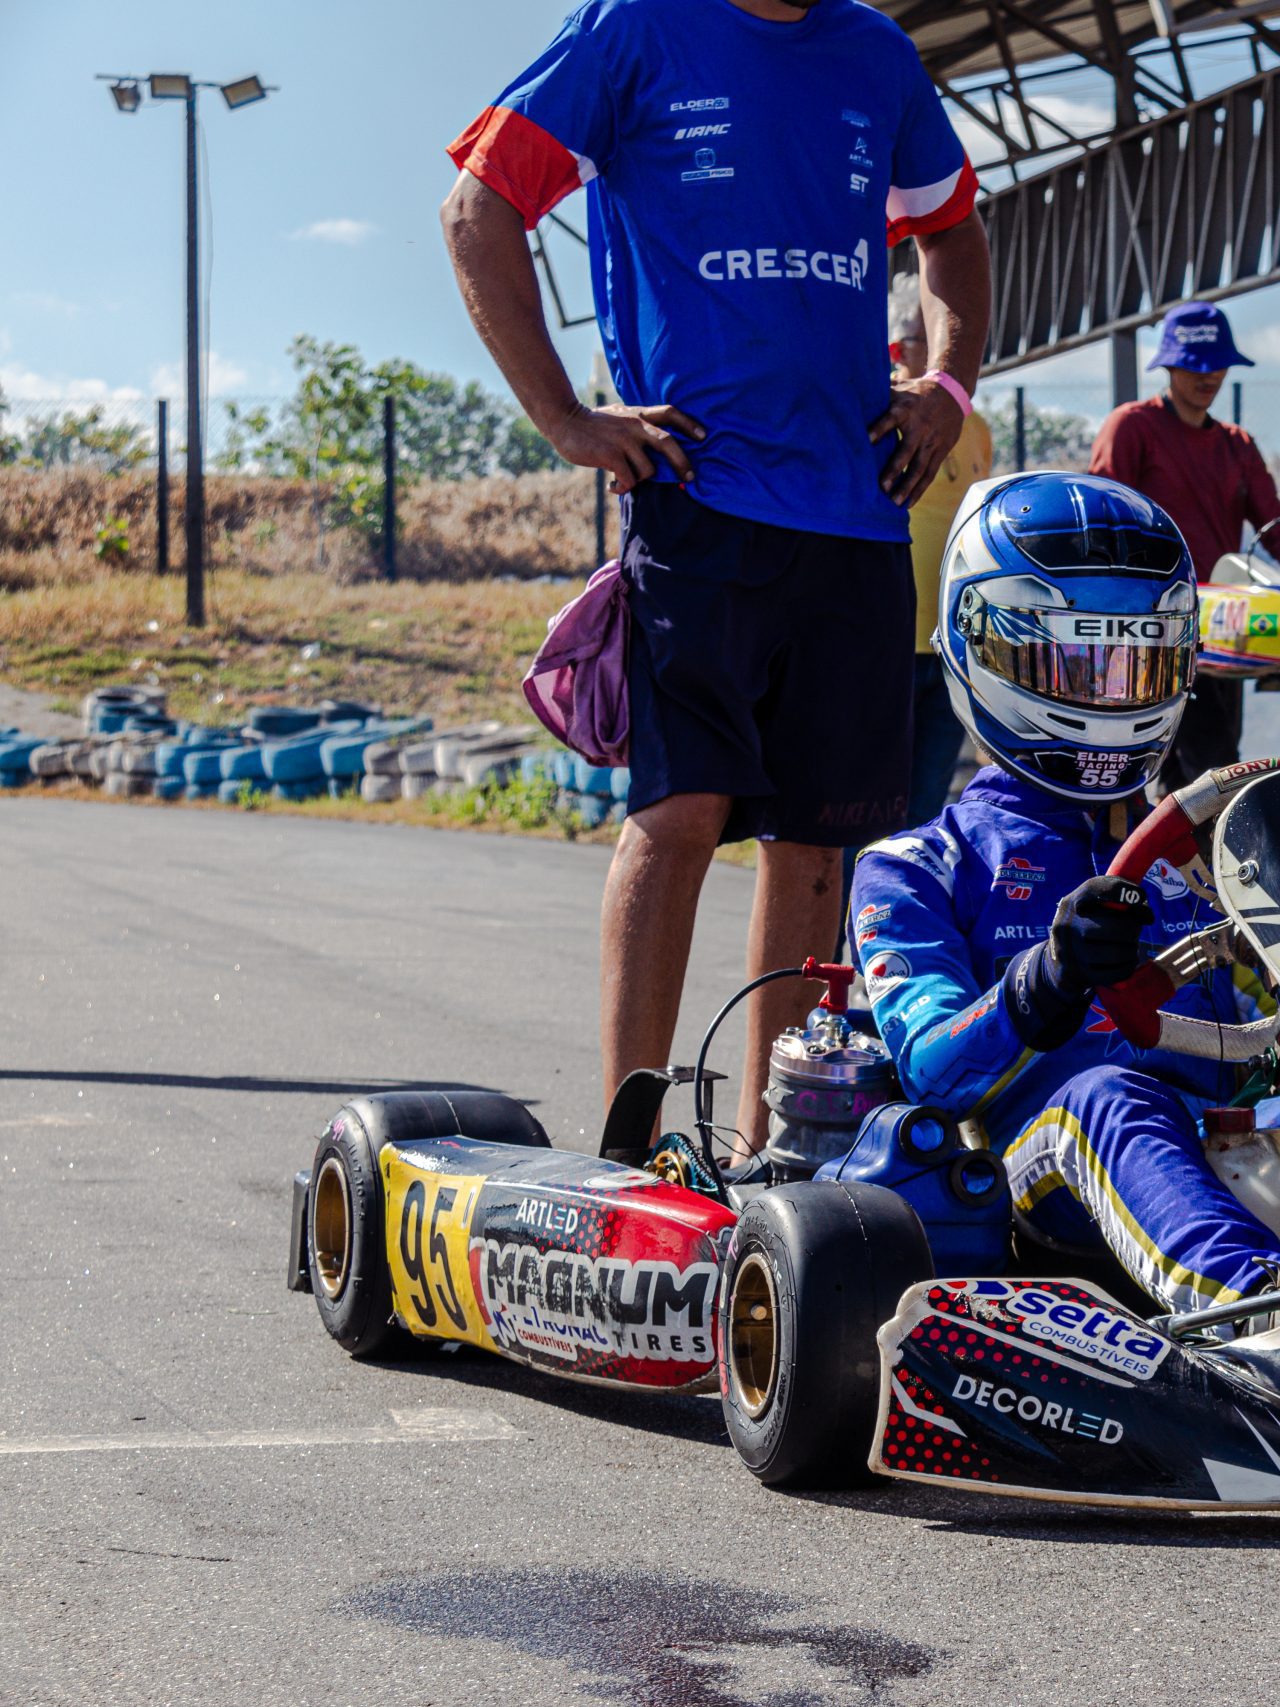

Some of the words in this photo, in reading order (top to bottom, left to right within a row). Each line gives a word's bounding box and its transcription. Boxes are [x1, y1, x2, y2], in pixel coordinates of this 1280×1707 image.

[699, 247, 869, 291] CRESCER
[1074, 619, 1165, 639] EIKO
[1076, 751, 1129, 763] ELDER
[1078, 761, 1126, 770] RACING
[1079, 767, 1121, 788] 55
[515, 1197, 579, 1235] ARTLED
[400, 1180, 468, 1330] 95
[487, 1250, 711, 1328] MAGNUM
[611, 1330, 707, 1354] TIRES
[1012, 1288, 1164, 1362] setta
[1028, 1320, 1150, 1376] COMBUSTÍVEIS
[951, 1373, 1125, 1445] DECORLED
